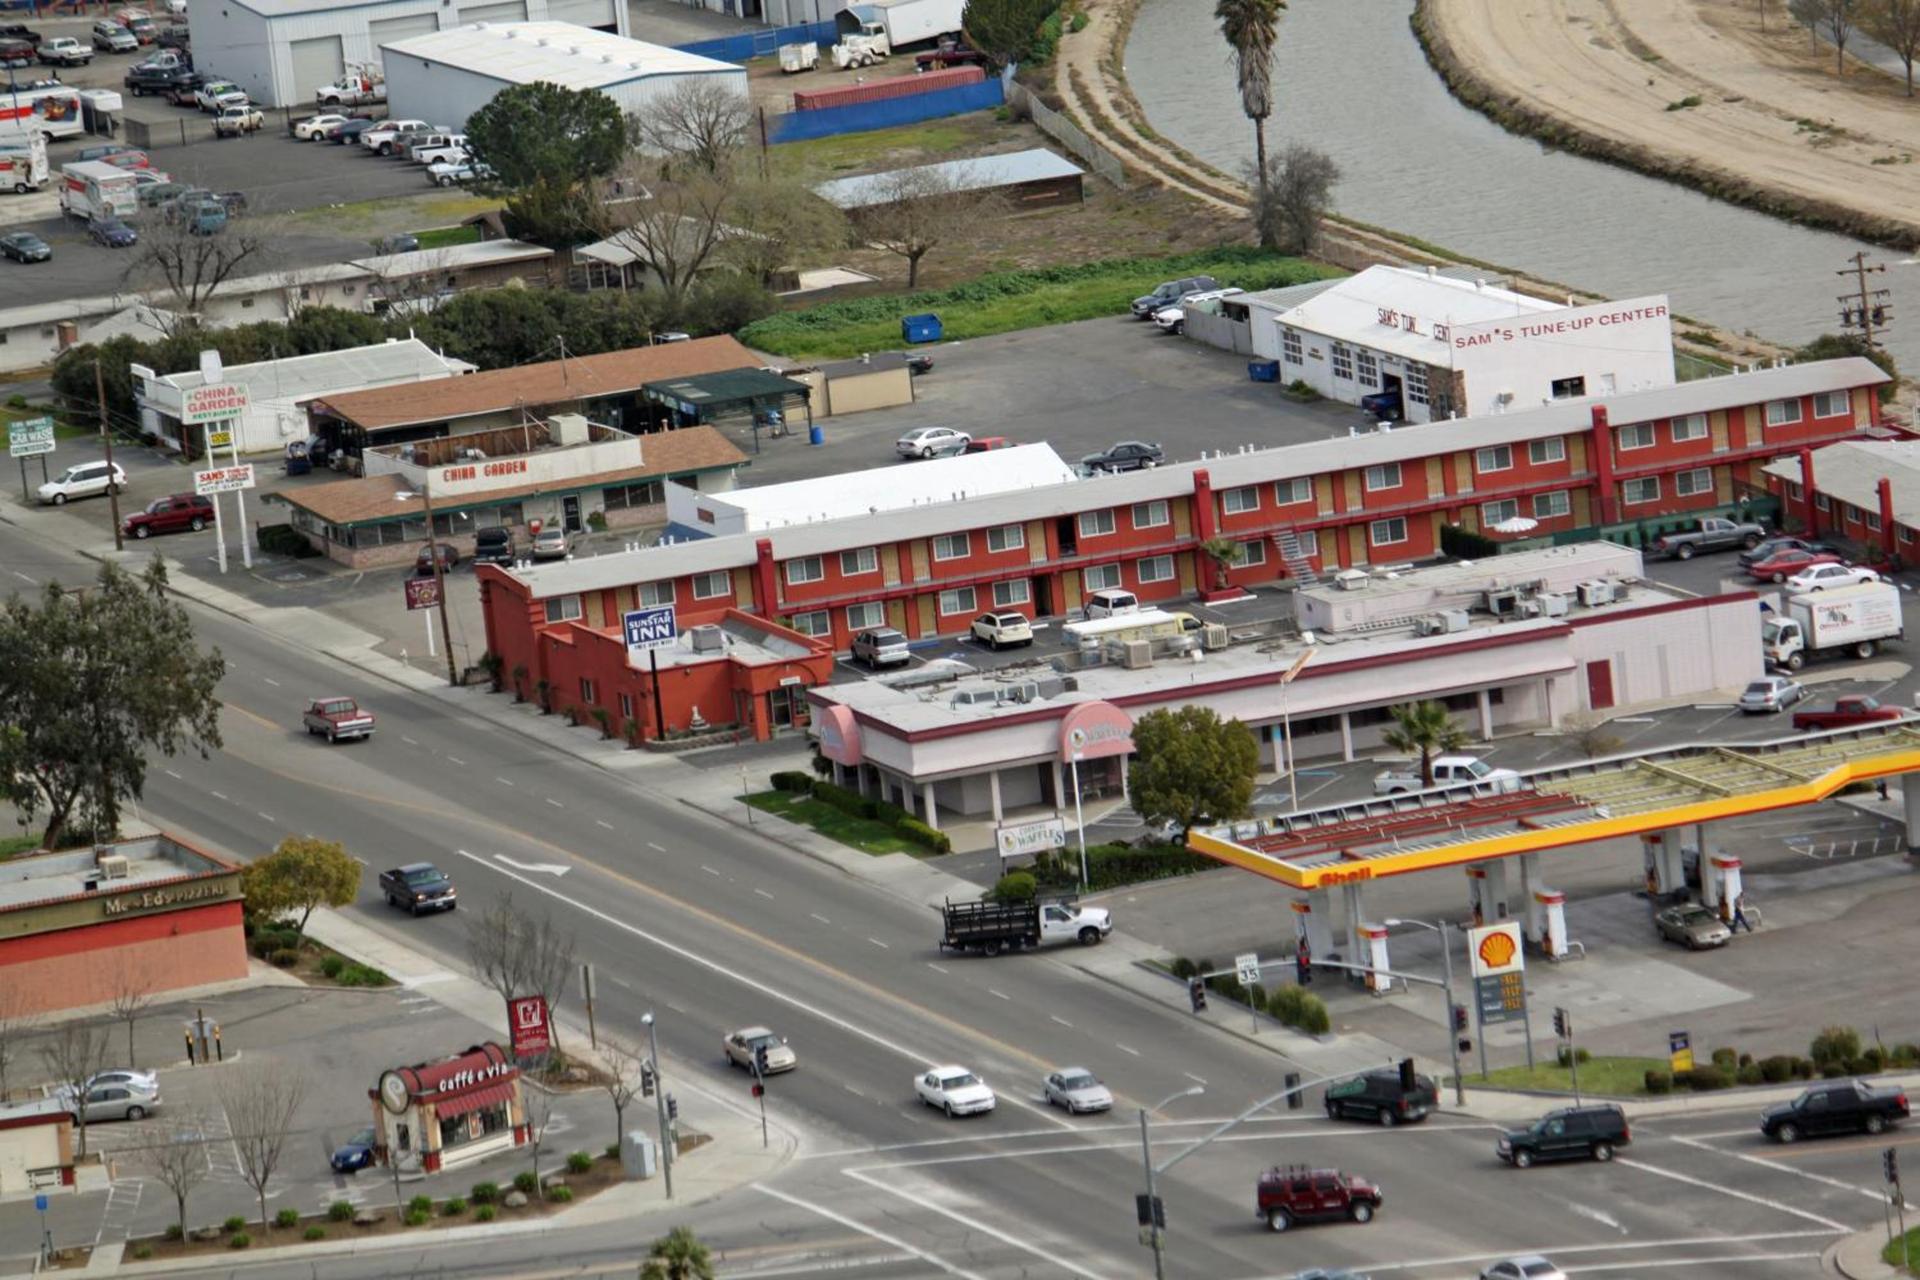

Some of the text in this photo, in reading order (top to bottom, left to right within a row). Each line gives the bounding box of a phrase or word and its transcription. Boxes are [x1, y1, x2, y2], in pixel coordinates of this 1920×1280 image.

[1521, 316, 1594, 338] TUNE-UP
[1599, 305, 1667, 325] CENTER
[194, 387, 235, 401] CHINA
[187, 396, 246, 413] GARDEN
[443, 460, 527, 482] CHINA GARDEN
[629, 613, 671, 629] SUNSTAR
[632, 624, 670, 642] INN
[1319, 867, 1371, 886] Shell
[1240, 968, 1258, 982] 35
